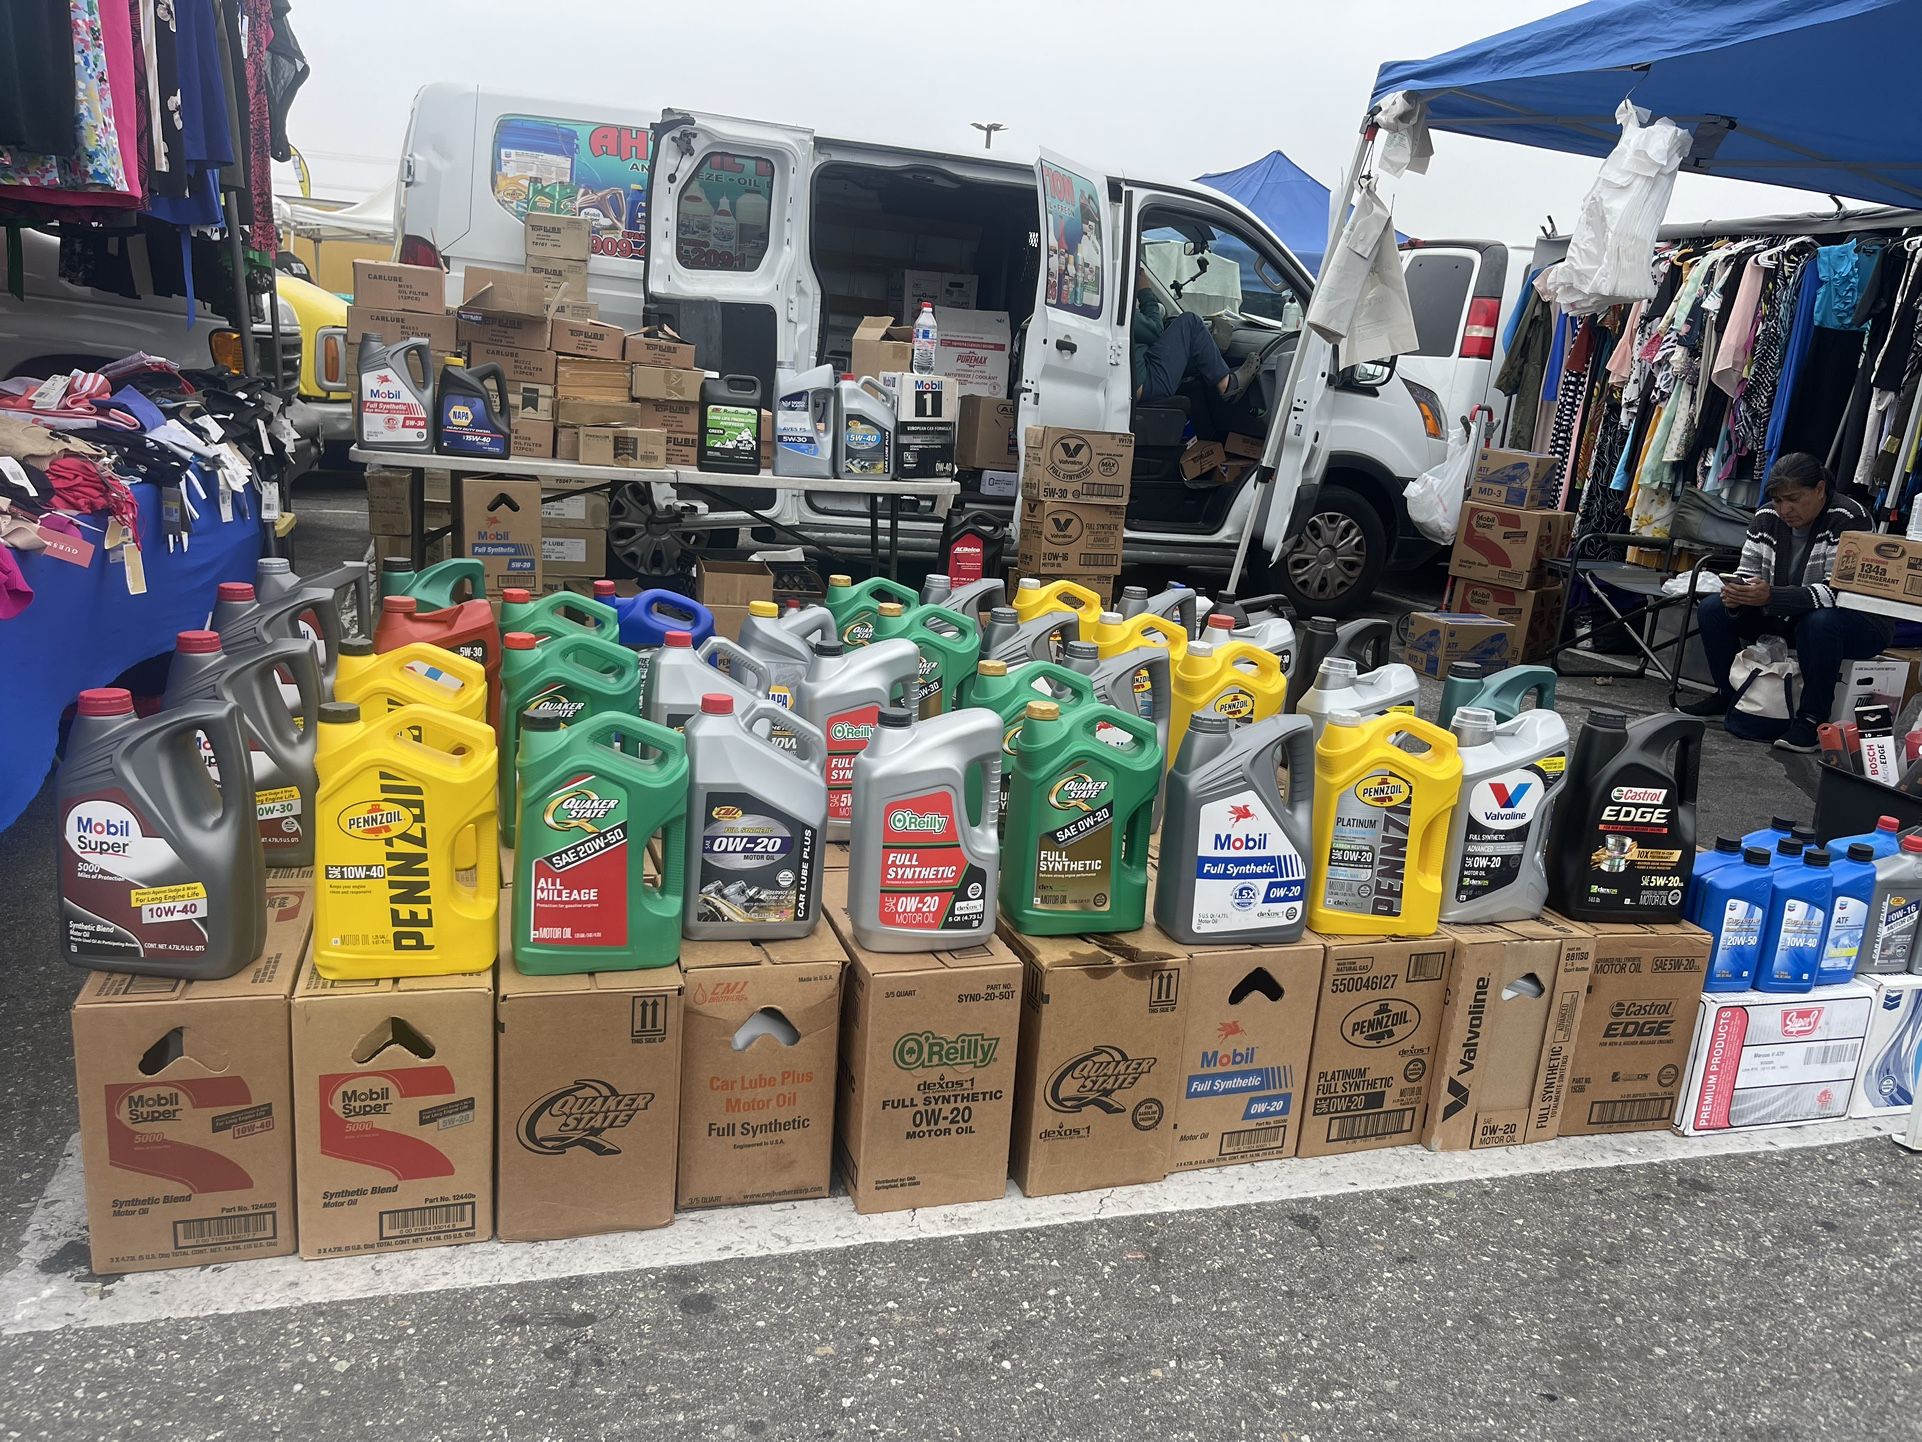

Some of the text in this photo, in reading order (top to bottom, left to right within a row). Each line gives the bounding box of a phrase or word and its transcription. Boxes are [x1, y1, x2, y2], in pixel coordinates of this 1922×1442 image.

[589, 126, 654, 161] AH
[737, 178, 761, 188] OIL
[368, 274, 403, 283] CARLUBE
[370, 315, 406, 324] CARLUBE
[486, 350, 519, 358] CARLUBE
[956, 354, 988, 365] PUREMAX
[915, 381, 942, 390] Mobil
[370, 389, 400, 399] Mobil
[378, 402, 407, 411] Synthetic
[923, 393, 933, 417] 1
[453, 410, 469, 421] NAPA
[465, 434, 491, 443] 15W-40
[850, 434, 877, 443] 5W-40
[1043, 488, 1068, 498] 5W-30
[1478, 487, 1502, 497] MD-3
[1476, 512, 1496, 523] Mobil
[477, 531, 509, 541] Mobil
[487, 546, 516, 554] Synthetic
[1047, 553, 1069, 561] 0W-16
[511, 561, 531, 569] 5W-20
[1860, 562, 1887, 576] 134a
[1857, 573, 1899, 585] REFRIGERANT
[1471, 589, 1491, 599] Mobil
[460, 647, 483, 658] 5W-30
[1448, 642, 1458, 650] ATF
[1408, 653, 1424, 666] MD-3
[538, 701, 584, 710] QUAKER
[1219, 700, 1249, 712] PENNZOIL
[1867, 744, 1879, 776] BOSCH
[1064, 781, 1107, 790] QUAKER
[1363, 785, 1403, 798] PENNZOIL
[1068, 790, 1100, 799] STATE
[1623, 789, 1662, 802] Castrol
[562, 798, 619, 810] QUAKER
[348, 810, 402, 829] PENNZOIL
[567, 808, 608, 818] STATE
[1484, 811, 1527, 821] Valvoline
[1601, 805, 1672, 823] EDGE
[77, 815, 129, 836] Mobil
[890, 811, 947, 832] O'Reilly
[1056, 808, 1110, 842] SAE 0W-20
[1336, 817, 1377, 829] PLATINUM
[77, 835, 129, 856] Super
[552, 828, 624, 868] SAE 20W-50
[712, 837, 781, 852] 0W-20
[1214, 833, 1267, 850] Mobil
[887, 853, 919, 865] FULL
[1040, 851, 1069, 860] FULL
[1343, 852, 1373, 862] 0W-20
[1473, 856, 1501, 868] 0W-20
[77, 862, 100, 873] 5000
[1039, 860, 1102, 871] SYNTHETIC
[1203, 862, 1275, 876] Full Synthetic
[328, 866, 384, 879] SAE 10W-40
[797, 829, 812, 917] CAR LUBE PLUS
[887, 866, 956, 879] SYNTHETIC
[537, 878, 564, 889] ALL
[1640, 875, 1680, 887] SAE 5W-20
[536, 889, 598, 900] MILEAGE
[1270, 886, 1301, 898] 0W-20
[885, 895, 939, 912] SAE 0W-20
[148, 903, 198, 918] 10W-40
[1889, 904, 1917, 922] 0W-16
[895, 913, 935, 924] MOTOR OIL
[1836, 916, 1849, 924] ATF
[69, 921, 114, 933] Synthetic Blend
[1727, 936, 1758, 946] 20W-50
[1787, 937, 1817, 948] 10W-40
[1594, 961, 1642, 974] MOTOR OIL
[1654, 958, 1695, 971] SAE 5W-20
[1331, 974, 1398, 994] 550046127
[1625, 1001, 1671, 1016] Castrol
[1351, 1009, 1409, 1037] PENNZOIL
[1458, 976, 1489, 1076] Valvoline
[1602, 1019, 1675, 1038] EDGE
[894, 1031, 999, 1070] O'Reilly
[1201, 1047, 1255, 1068] Mobil
[1072, 1057, 1157, 1079] QUAKER
[1699, 1074, 1717, 1126] PREMIUM
[1710, 1010, 1732, 1071] PRODUCTS
[709, 1070, 814, 1092] Car Lube Plus
[1318, 1067, 1367, 1083] PLATINUM
[1077, 1073, 1142, 1093] STATE
[1190, 1075, 1262, 1092] Full Synthetic
[1316, 1077, 1394, 1096] FULL SYNTHETIC
[1536, 1046, 1563, 1129] FULL SYNTHETIC
[128, 1092, 179, 1109] Mobil
[341, 1087, 389, 1103] Mobil
[881, 1090, 1003, 1110] FULL SYNTHETIC
[550, 1092, 655, 1116] QUAKER
[725, 1092, 797, 1113] Motor Oil
[1250, 1101, 1283, 1114] 0W-20
[1329, 1096, 1365, 1112] 0W-20
[128, 1108, 178, 1122] Super
[342, 1102, 389, 1117] Super
[559, 1110, 637, 1132] STATE
[912, 1106, 973, 1127] 0W-20
[345, 1122, 374, 1132] 5000
[707, 1115, 810, 1138] Full Synthetic
[905, 1126, 976, 1140] MOTOR OIL
[1481, 1123, 1517, 1135] 0W-20
[134, 1133, 164, 1144] 5000
[1479, 1134, 1517, 1145] MOTOR OIL
[322, 1184, 398, 1200] Synthetic Blend
[112, 1193, 192, 1209] Synthetic Blend
[322, 1200, 346, 1209] Motor
[112, 1207, 149, 1217] Motor Oil
